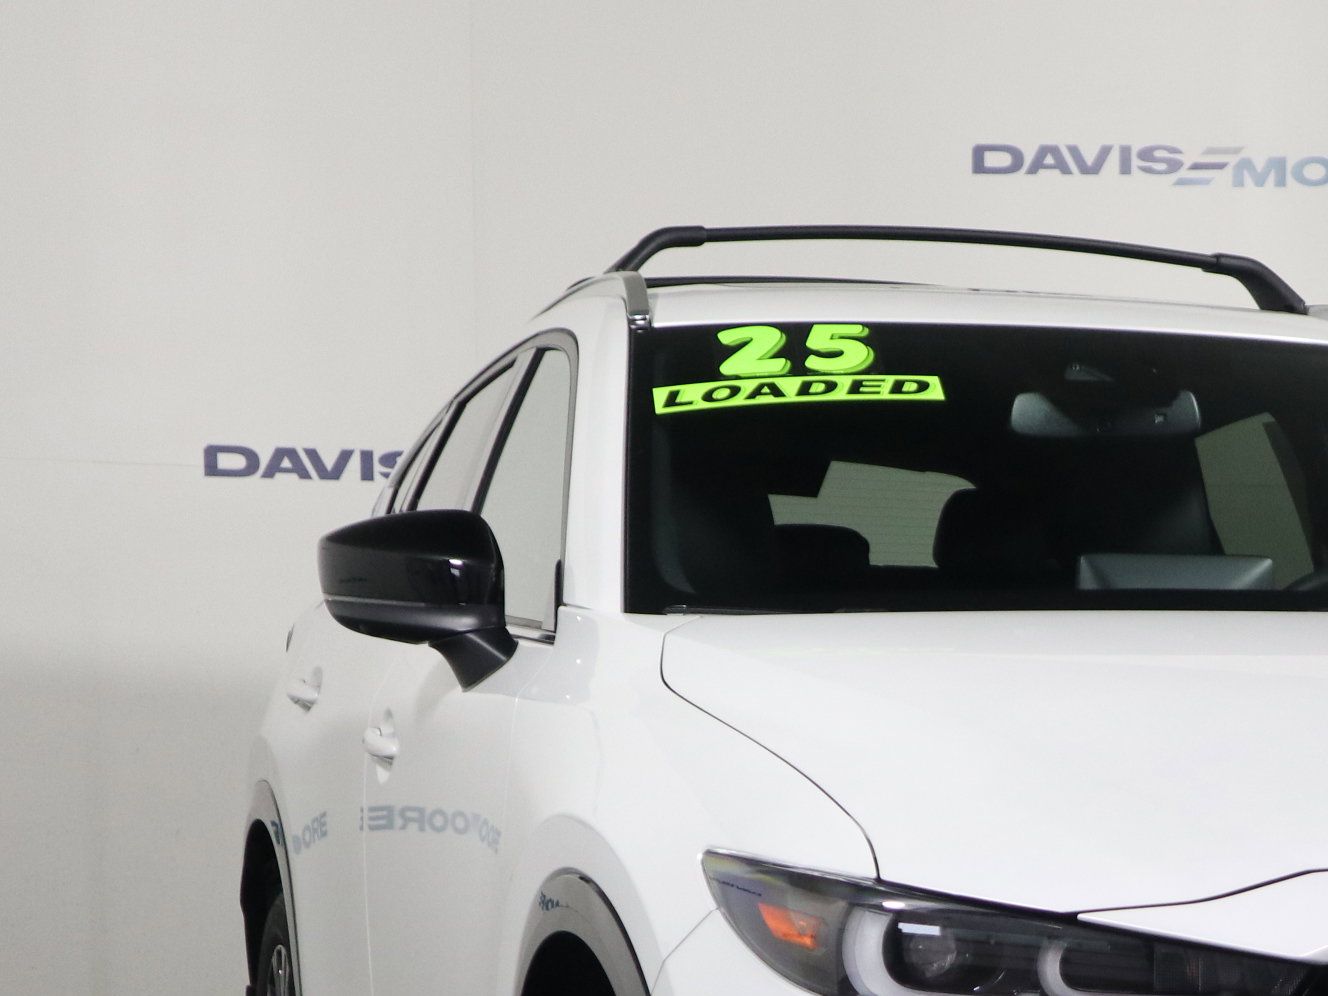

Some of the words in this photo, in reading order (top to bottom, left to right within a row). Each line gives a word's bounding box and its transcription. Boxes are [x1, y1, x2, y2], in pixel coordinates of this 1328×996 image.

[971, 143, 1184, 176] DAVIS
[716, 323, 875, 377] 25
[661, 377, 936, 409] LOADED
